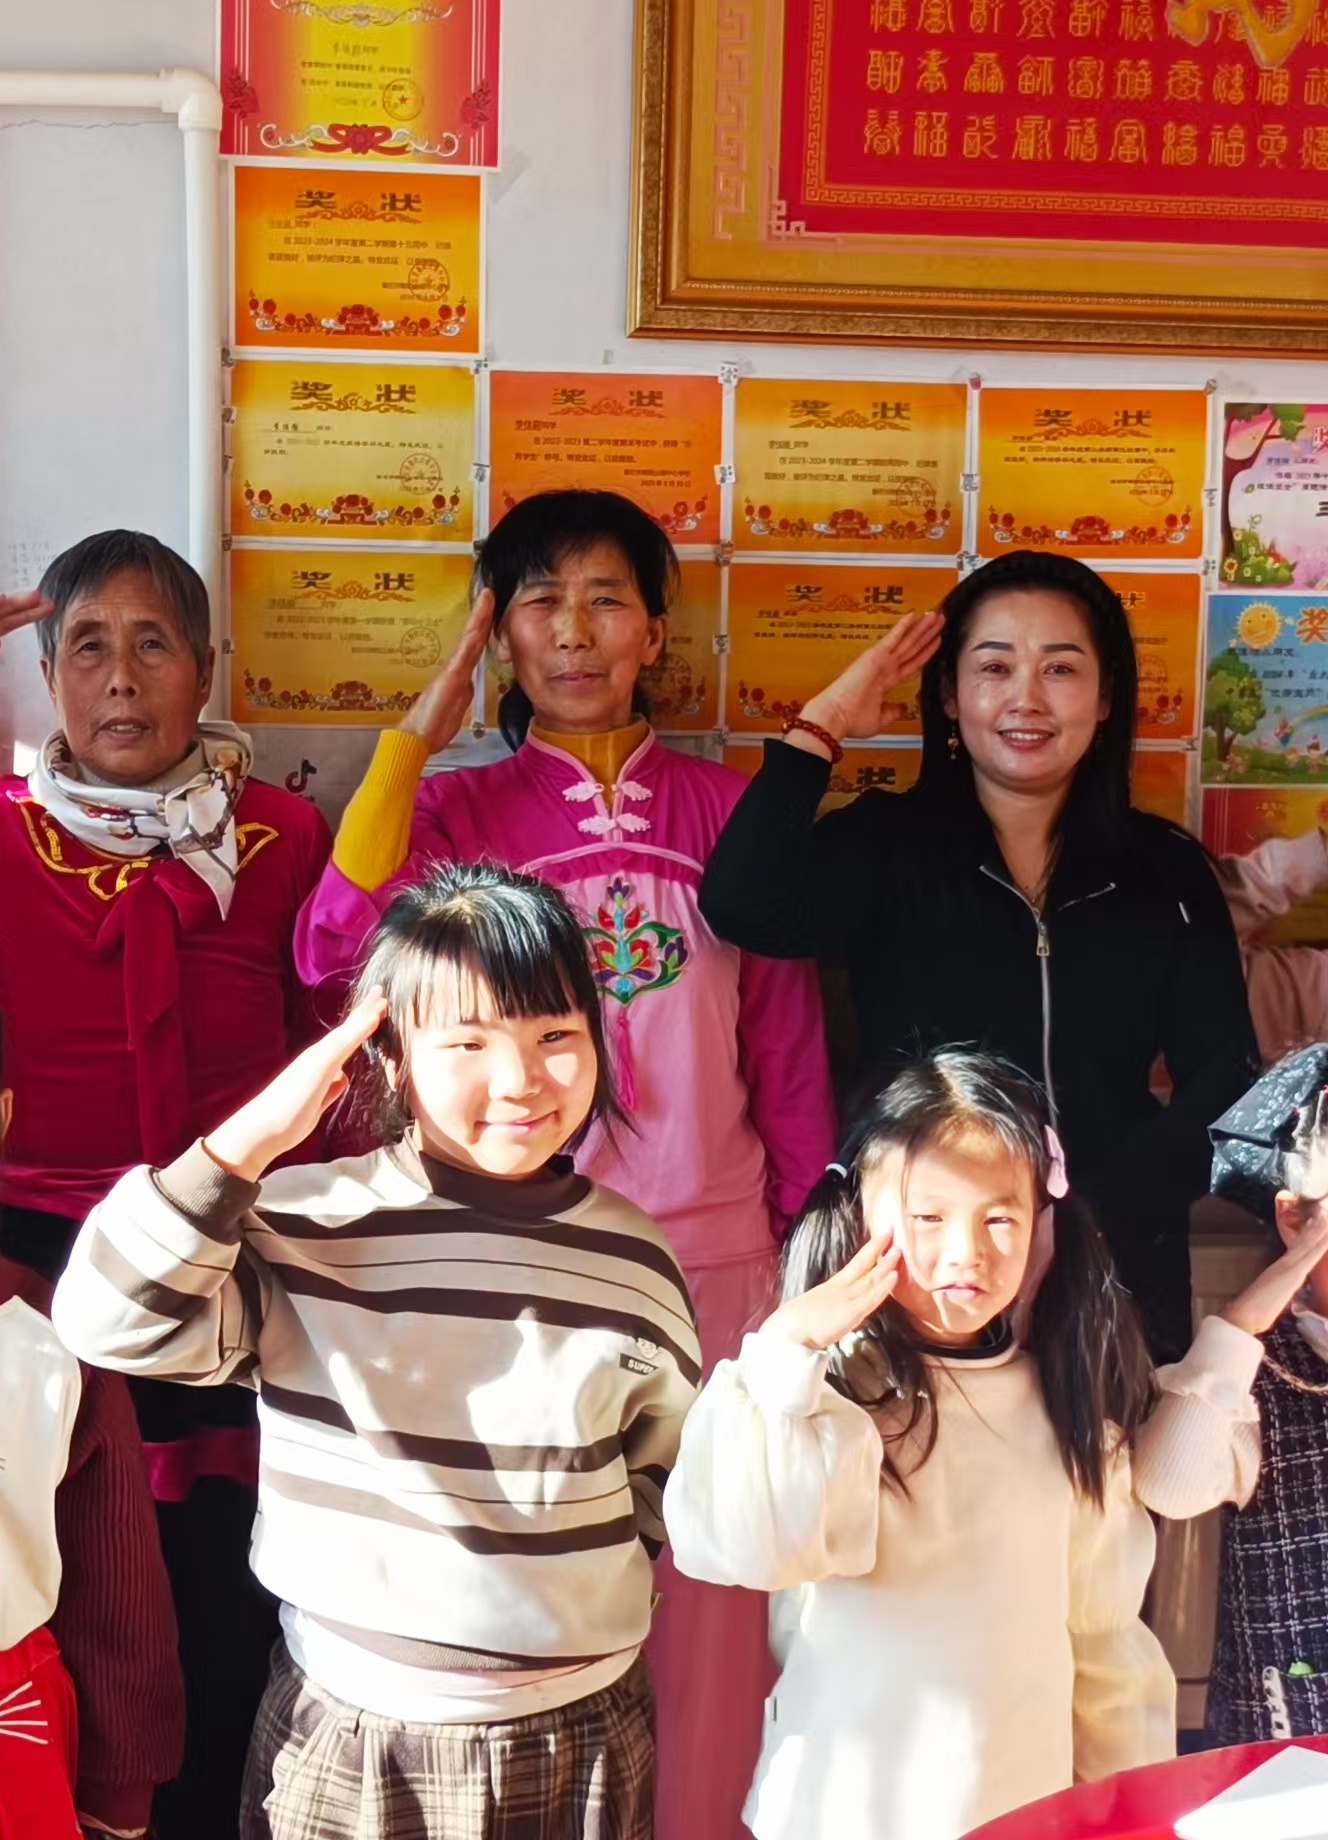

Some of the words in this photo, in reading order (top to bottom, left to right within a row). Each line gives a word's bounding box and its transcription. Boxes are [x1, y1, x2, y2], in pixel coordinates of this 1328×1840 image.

[294, 189, 422, 212] 奖状
[290, 380, 416, 403] 奖状
[551, 388, 664, 408] 奖状
[788, 399, 912, 421] 奖状
[1033, 408, 1153, 428] 奖状
[290, 570, 415, 592] 奖状
[786, 583, 904, 605] 奖状
